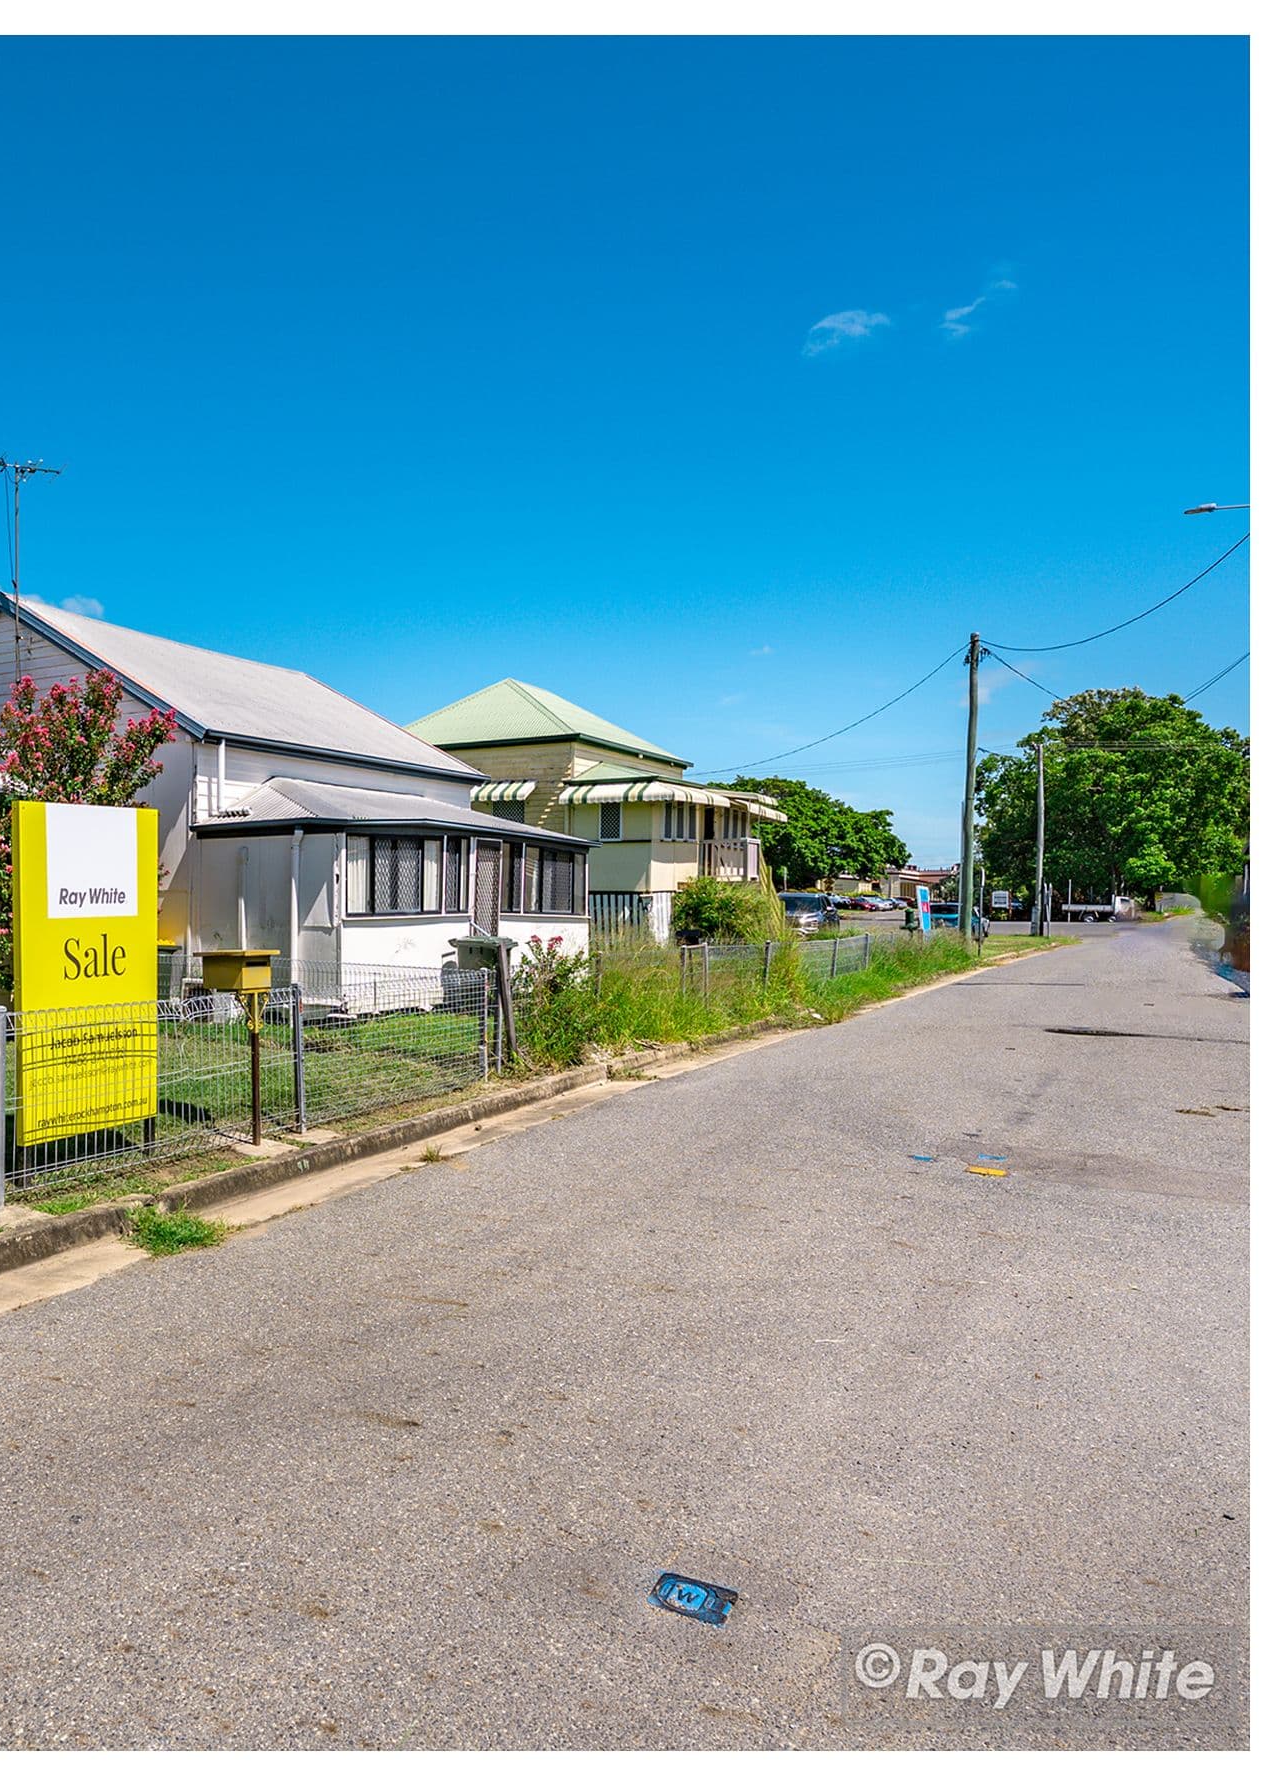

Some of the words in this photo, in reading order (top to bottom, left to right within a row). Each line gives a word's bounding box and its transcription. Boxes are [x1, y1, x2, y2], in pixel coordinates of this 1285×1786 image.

[58, 888, 87, 908] Ray
[89, 887, 126, 905] White
[63, 932, 127, 981] Sale
[676, 1587, 700, 1604] W
